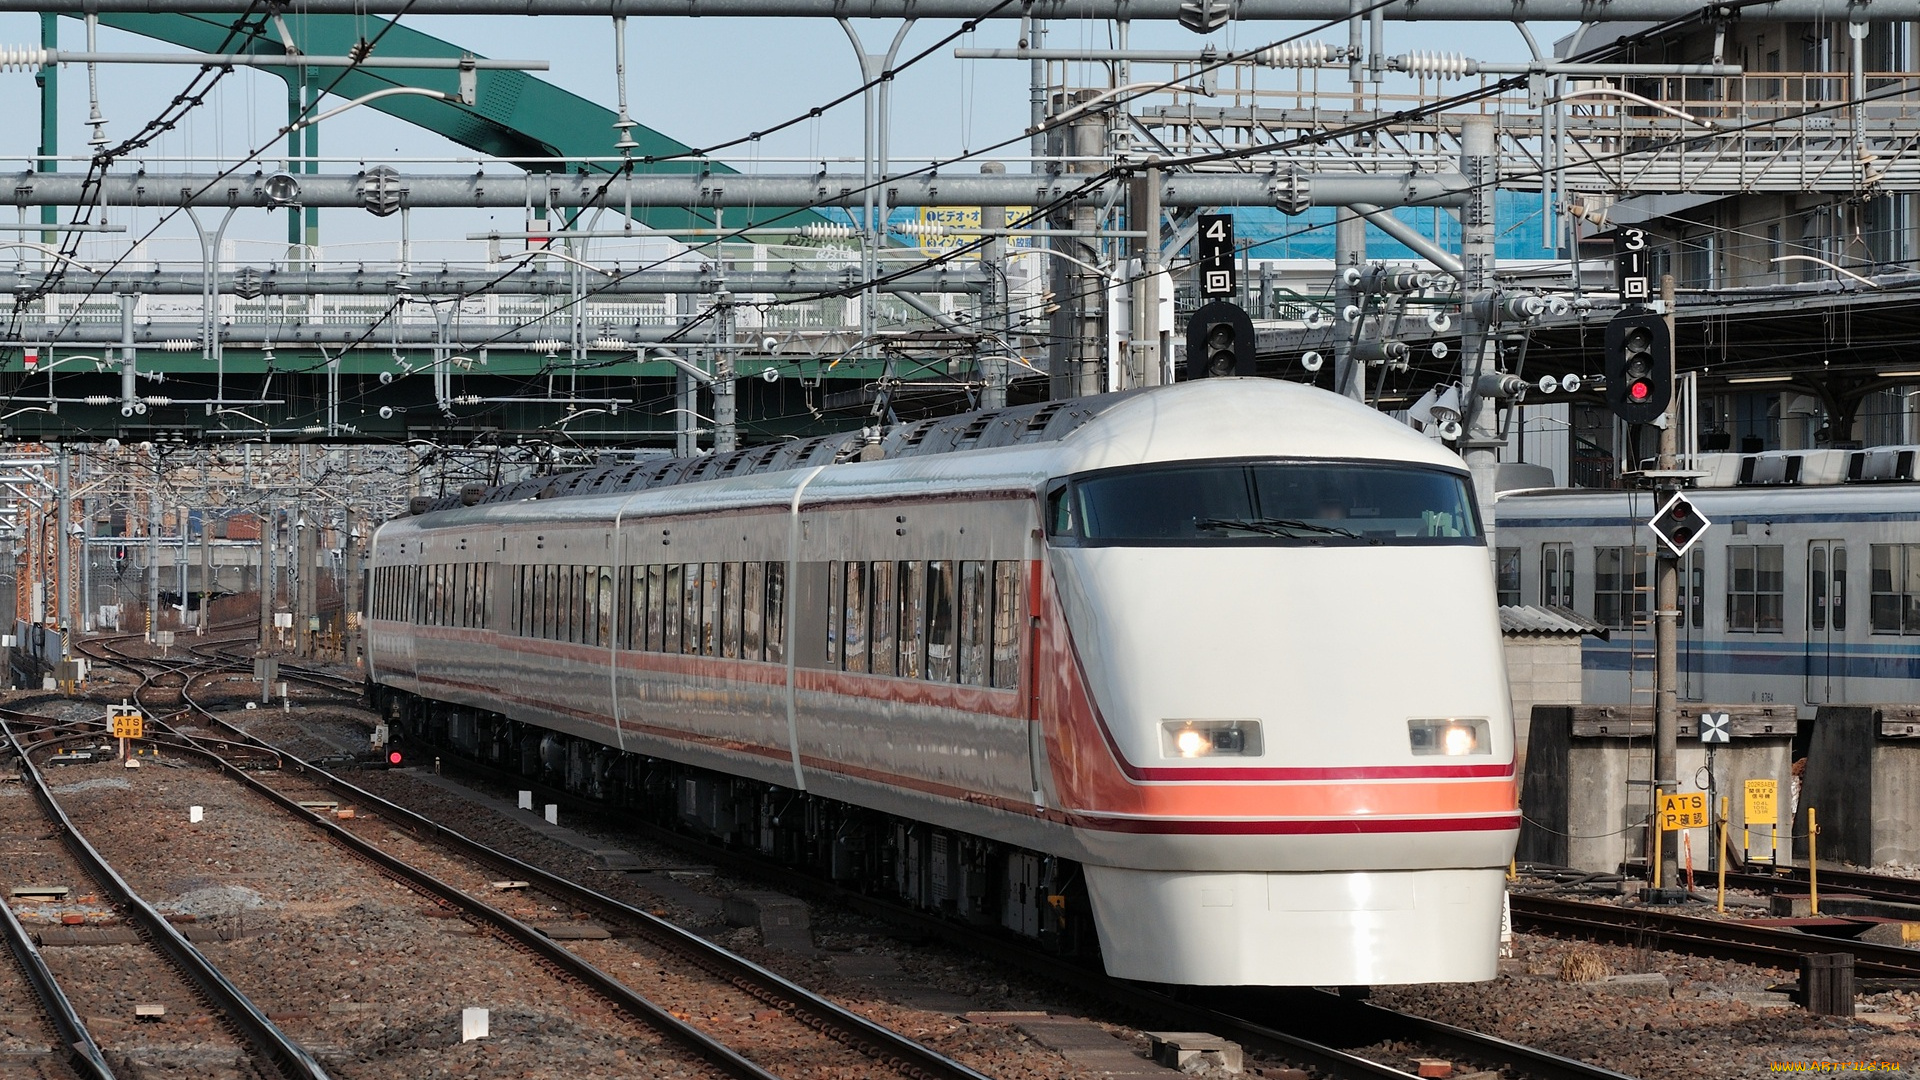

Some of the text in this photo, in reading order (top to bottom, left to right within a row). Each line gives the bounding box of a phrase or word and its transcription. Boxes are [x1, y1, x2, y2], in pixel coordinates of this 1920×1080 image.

[117, 718, 140, 726] ATS
[1666, 796, 1702, 811] ATS
[1666, 812, 1703, 826] P確認
